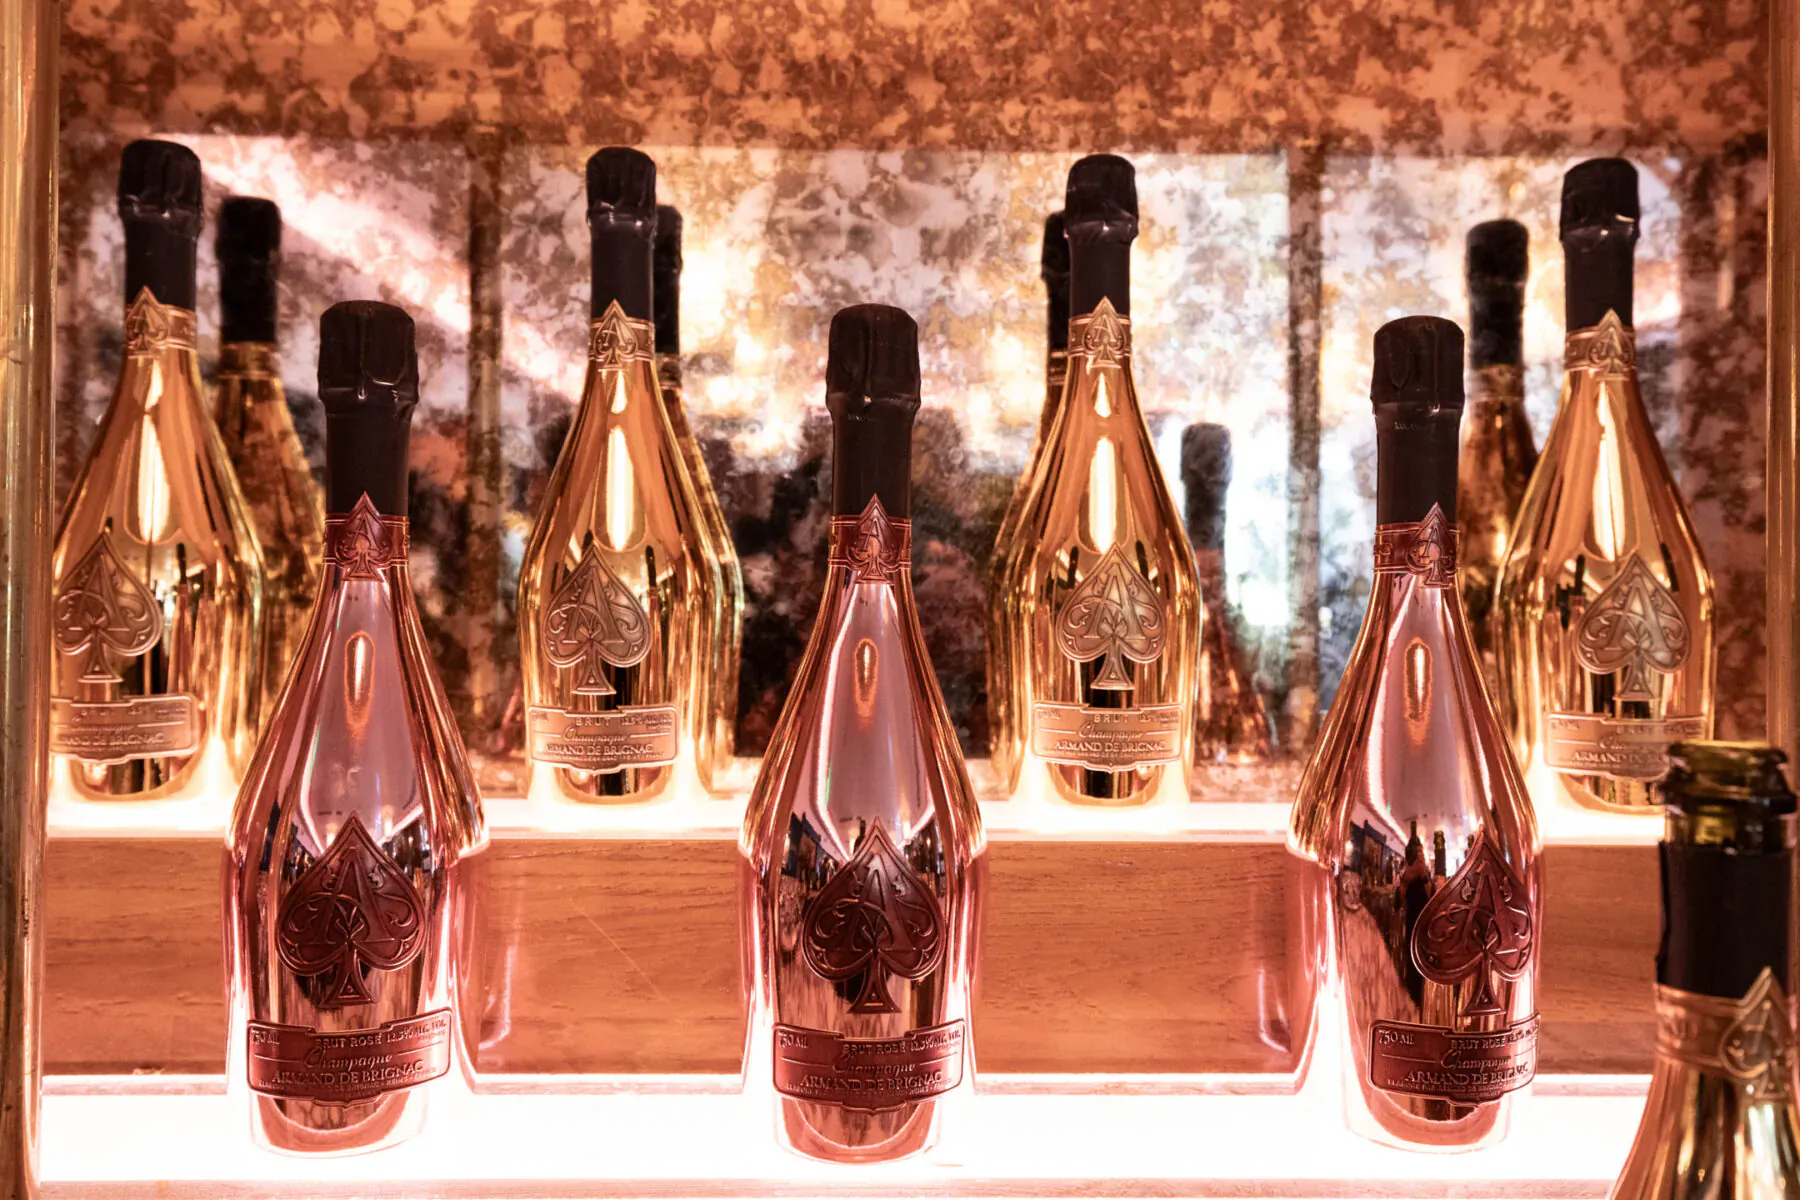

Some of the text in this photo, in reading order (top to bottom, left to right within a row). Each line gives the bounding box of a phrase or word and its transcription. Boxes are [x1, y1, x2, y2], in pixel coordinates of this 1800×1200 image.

[575, 717, 611, 727] BRUT
[1094, 714, 1129, 723] BRUT
[562, 725, 628, 746] Champagne
[1078, 722, 1143, 742] Champagne
[587, 745, 602, 756] DE
[603, 743, 654, 756] BRIGNAC
[1054, 740, 1166, 753] ARMAND DE BRIGNAC
[315, 1037, 346, 1049] BRUT
[1378, 1029, 1414, 1045] 750 ML
[1450, 1038, 1480, 1050] BRUT
[843, 1043, 872, 1056] BRUT
[303, 1048, 393, 1072] Champagne
[832, 1052, 916, 1078] Champagne
[339, 1071, 359, 1085] DE
[362, 1059, 425, 1083] BRIGNAC
[1404, 1069, 1470, 1086] ARMAND
[1471, 1072, 1488, 1085] DE
[800, 1074, 861, 1091] ARMAND
[865, 1078, 884, 1091] DE
[887, 1070, 943, 1090] BRIGNAC
